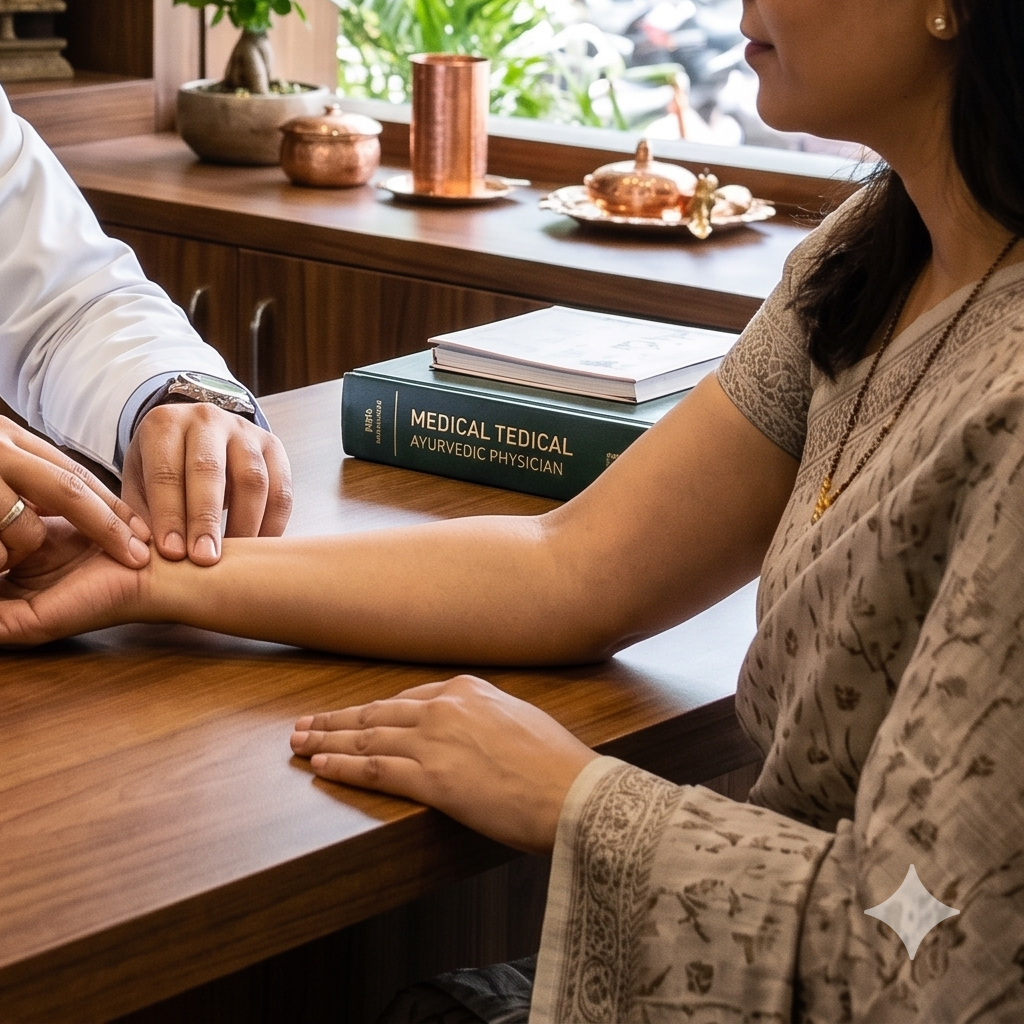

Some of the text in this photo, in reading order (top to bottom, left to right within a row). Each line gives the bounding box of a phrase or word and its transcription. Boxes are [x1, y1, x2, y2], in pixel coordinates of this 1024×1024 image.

[409, 434, 564, 476] AYURVEDIC PHYSICIAN
[410, 408, 492, 441] MEDICAL
[494, 423, 574, 457] TEDICAL
